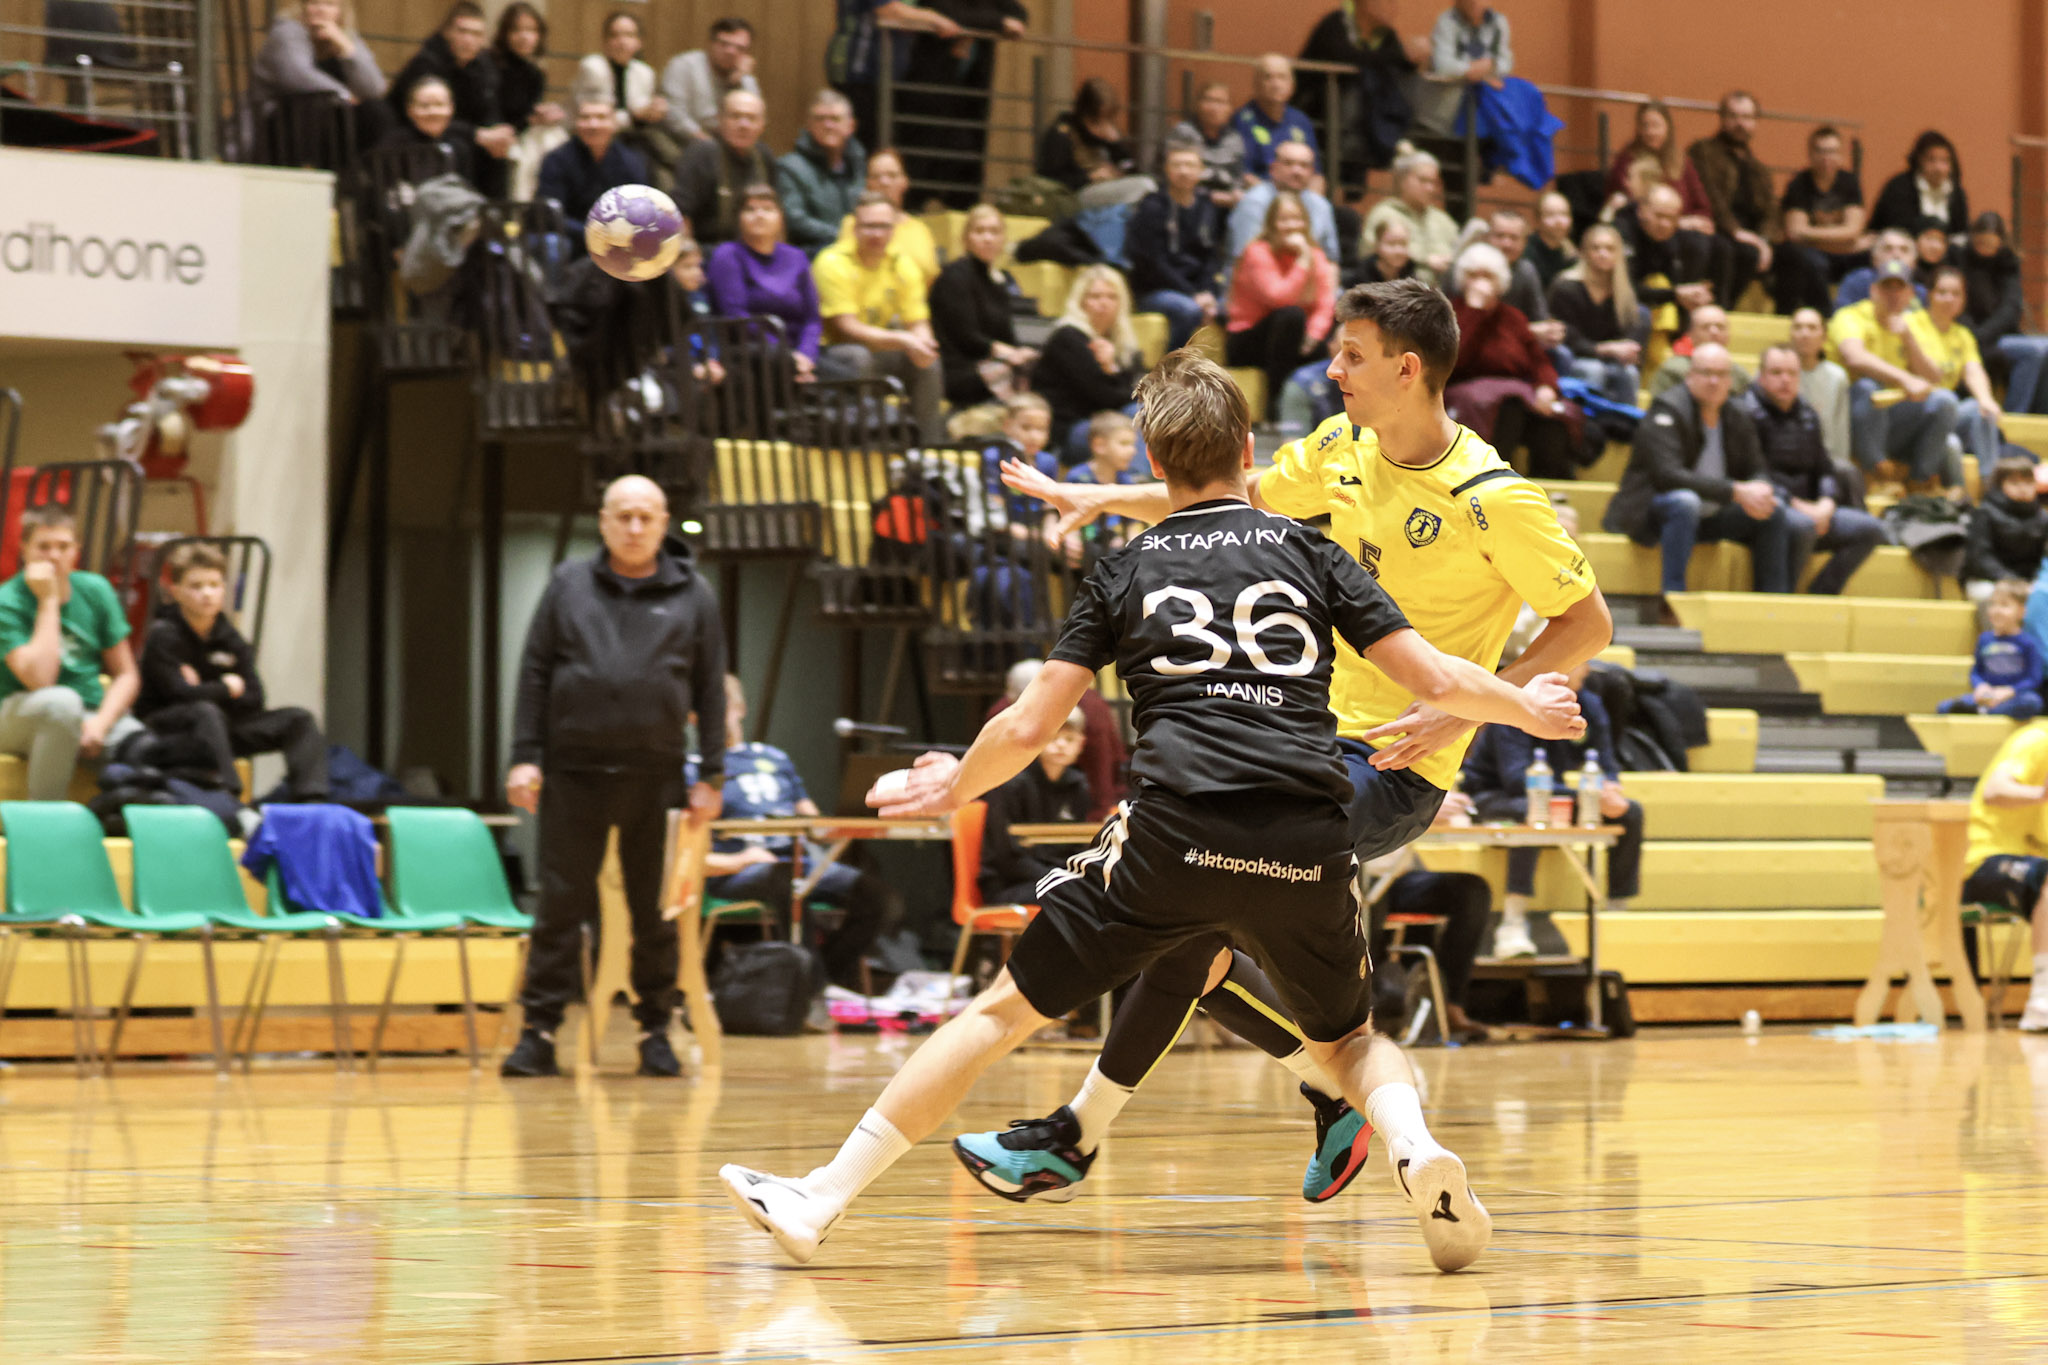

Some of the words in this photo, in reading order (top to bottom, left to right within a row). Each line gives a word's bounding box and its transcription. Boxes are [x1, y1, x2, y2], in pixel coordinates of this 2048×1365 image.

[0, 221, 206, 285] dihoone
[1141, 534, 1172, 551] SK
[1358, 536, 1382, 580] 5
[1142, 579, 1319, 677] 36
[1184, 847, 1323, 883] #sktapakäsipall
